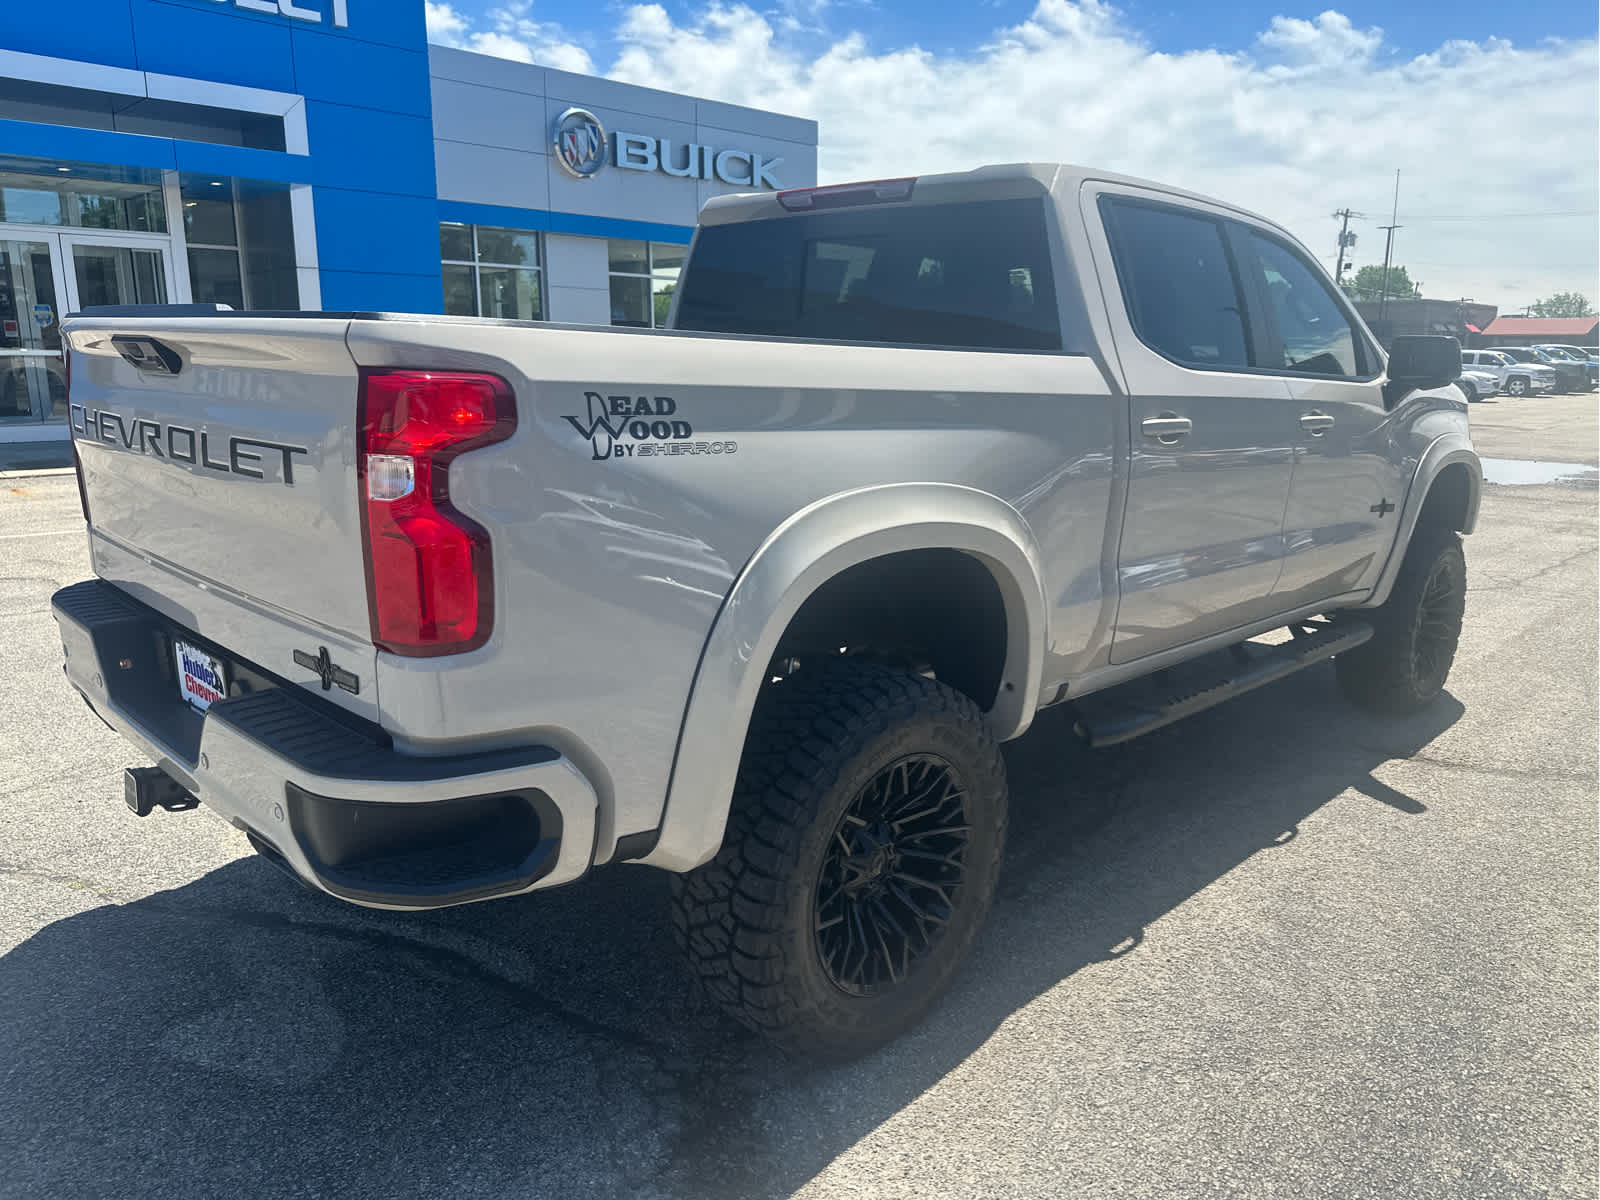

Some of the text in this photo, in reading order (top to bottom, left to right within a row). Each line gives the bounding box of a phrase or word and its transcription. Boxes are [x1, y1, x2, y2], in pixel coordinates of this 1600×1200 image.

[613, 131, 785, 189] BUICK
[560, 416, 692, 440] WOOD
[71, 404, 307, 486] CHEVROLET
[614, 441, 737, 458] BY SHERROD
[183, 655, 215, 686] Hubler
